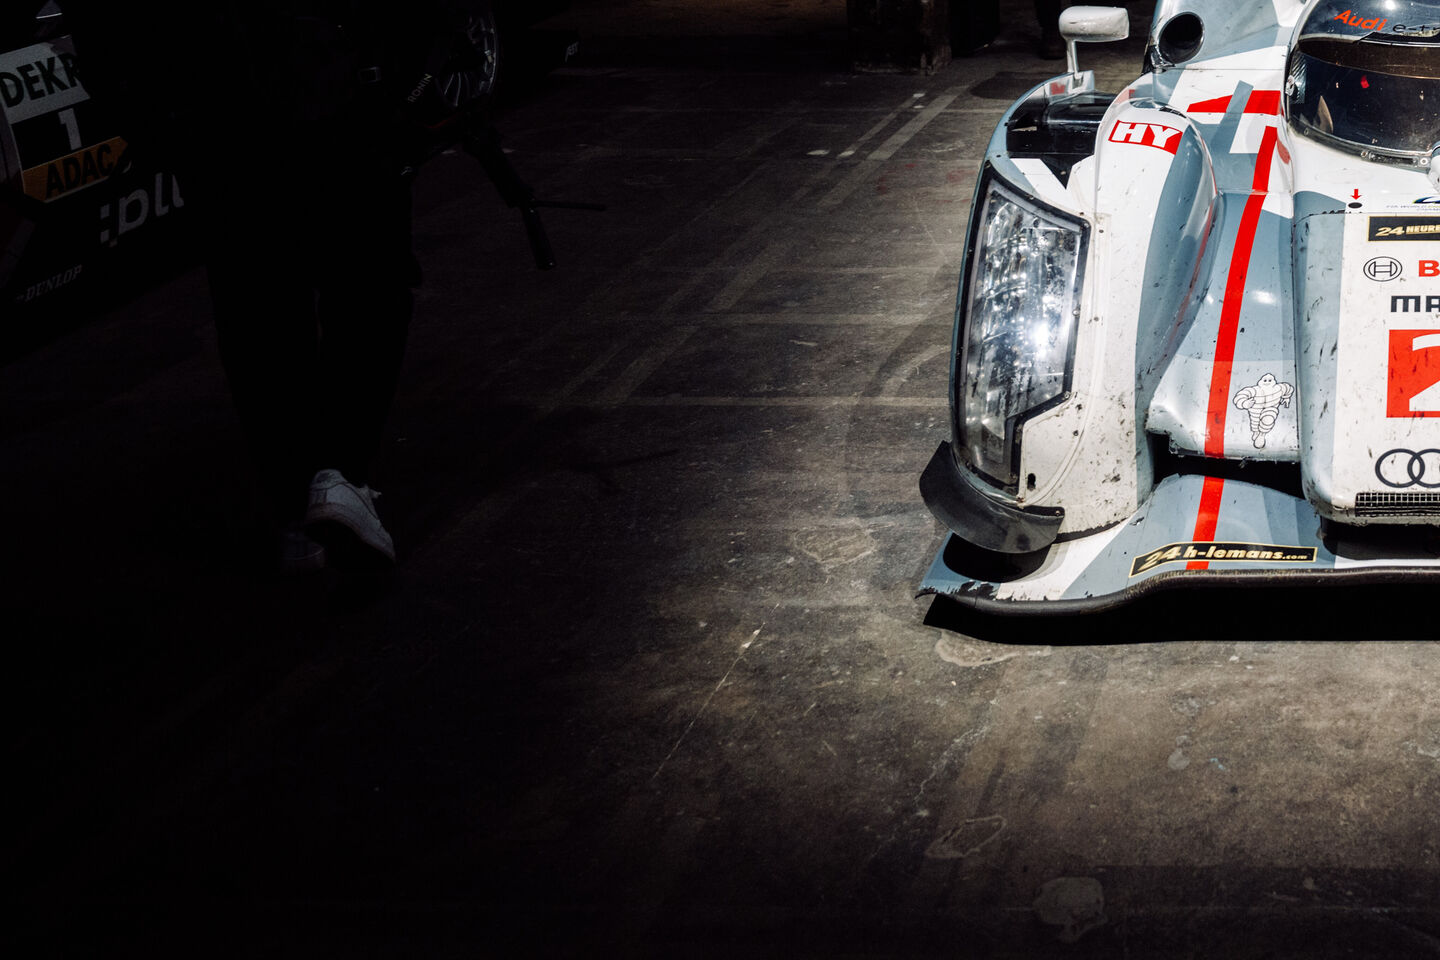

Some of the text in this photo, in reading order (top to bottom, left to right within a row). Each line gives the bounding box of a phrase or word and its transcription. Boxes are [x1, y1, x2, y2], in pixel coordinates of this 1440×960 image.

[1334, 9, 1388, 32] Audi
[407, 73, 433, 104] RONIN
[57, 106, 83, 150] 1
[1111, 122, 1180, 148] HY
[45, 143, 115, 198] ADAC
[1375, 226, 1405, 237] 24
[24, 263, 84, 302] DUNLOP
